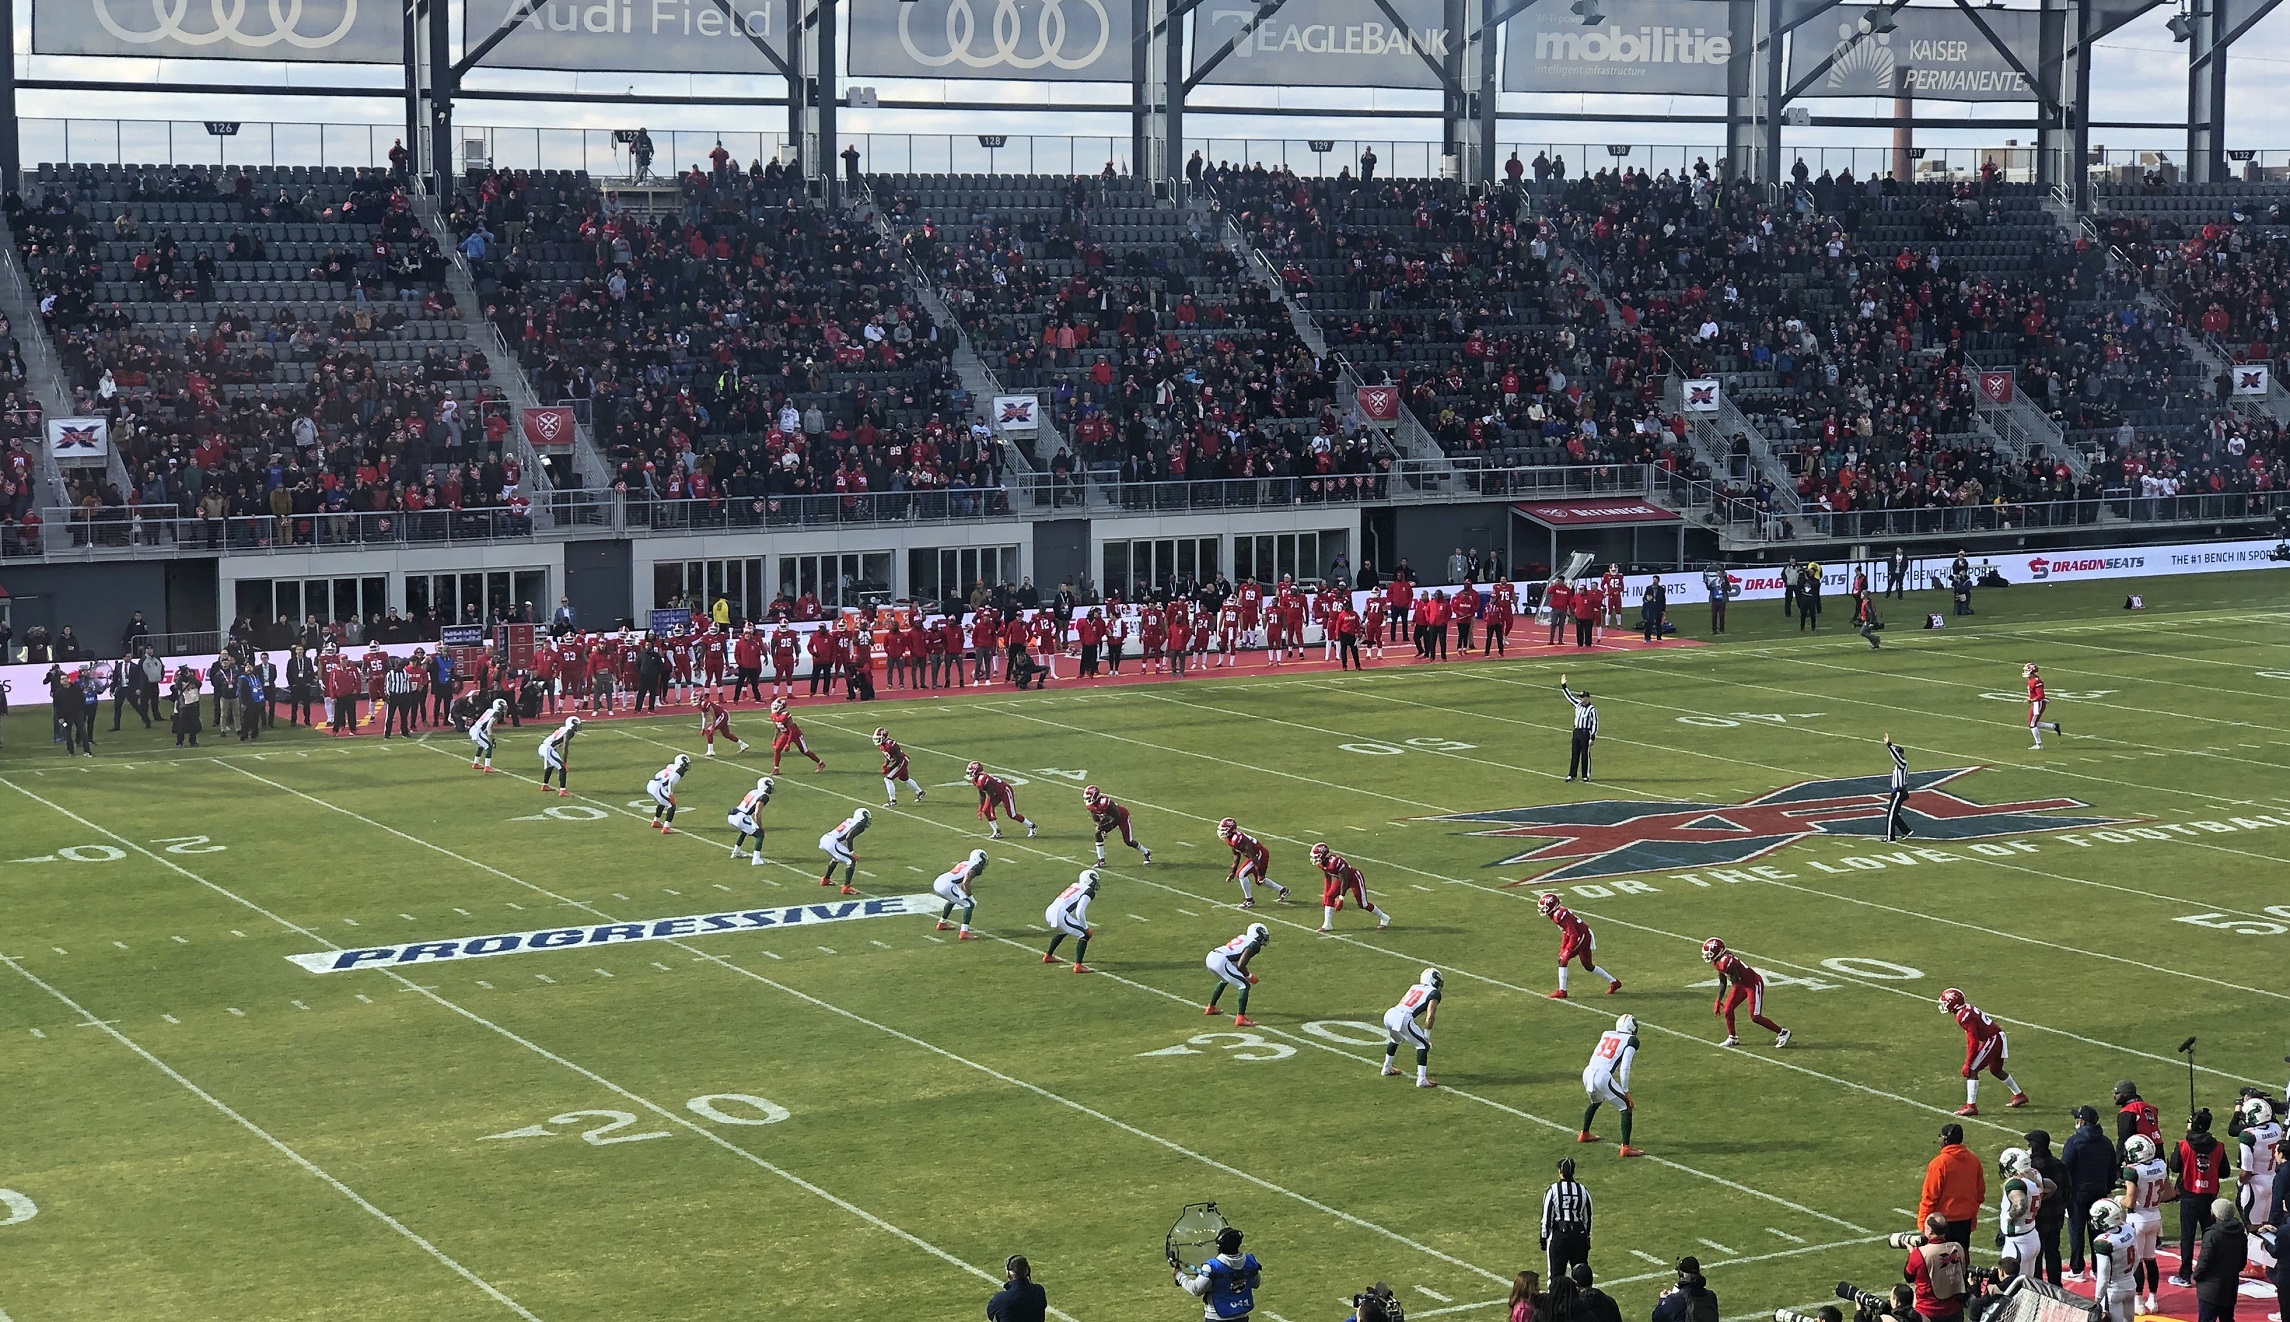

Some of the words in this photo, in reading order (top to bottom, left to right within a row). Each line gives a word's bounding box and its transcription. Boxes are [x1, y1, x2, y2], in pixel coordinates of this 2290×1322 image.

[499, 0, 632, 33] Audi
[651, 0, 771, 37] Field
[1535, 25, 1731, 65] mobilitie
[1909, 39, 1968, 61] KAISER
[1535, 65, 1583, 77] intelligent
[1585, 65, 1646, 77] infrastructure
[1904, 69, 2026, 92] PERMANENTE
[212, 123, 233, 133] 126
[984, 136, 1001, 146] 128
[1314, 141, 1329, 151] 129
[1612, 145, 1626, 155] 130
[1909, 148, 1921, 157] 131
[2234, 151, 2250, 160] 132
[1421, 212, 1428, 221] 12
[1480, 209, 1486, 218] 12
[1828, 425, 1835, 435] 12
[889, 446, 901, 456] 89
[1571, 505, 1655, 518] DEFENDERS
[2171, 555, 2189, 565] THE
[2191, 554, 2201, 564] #1
[2204, 552, 2233, 563] BENCH
[2236, 551, 2246, 561] IN
[2052, 556, 2144, 573] DRAGONSEATS
[1609, 579, 1620, 588] 42
[1369, 603, 1380, 613] 77
[2131, 596, 2141, 608] 10
[806, 604, 814, 615] 12
[1040, 619, 1049, 630] 12
[1269, 614, 1278, 624] 31
[370, 659, 383, 672] 56
[1338, 737, 1477, 756] 50
[58, 835, 227, 862] 20
[1668, 864, 1797, 888] THE
[1805, 848, 1960, 874] LOVE
[1967, 839, 2039, 857] OF
[331, 897, 906, 969] PROGRESSIVE
[1187, 1019, 1387, 1062] 30
[548, 1093, 791, 1146] 20
[2144, 1179, 2164, 1208] 13
[1562, 1195, 1579, 1210] 27
